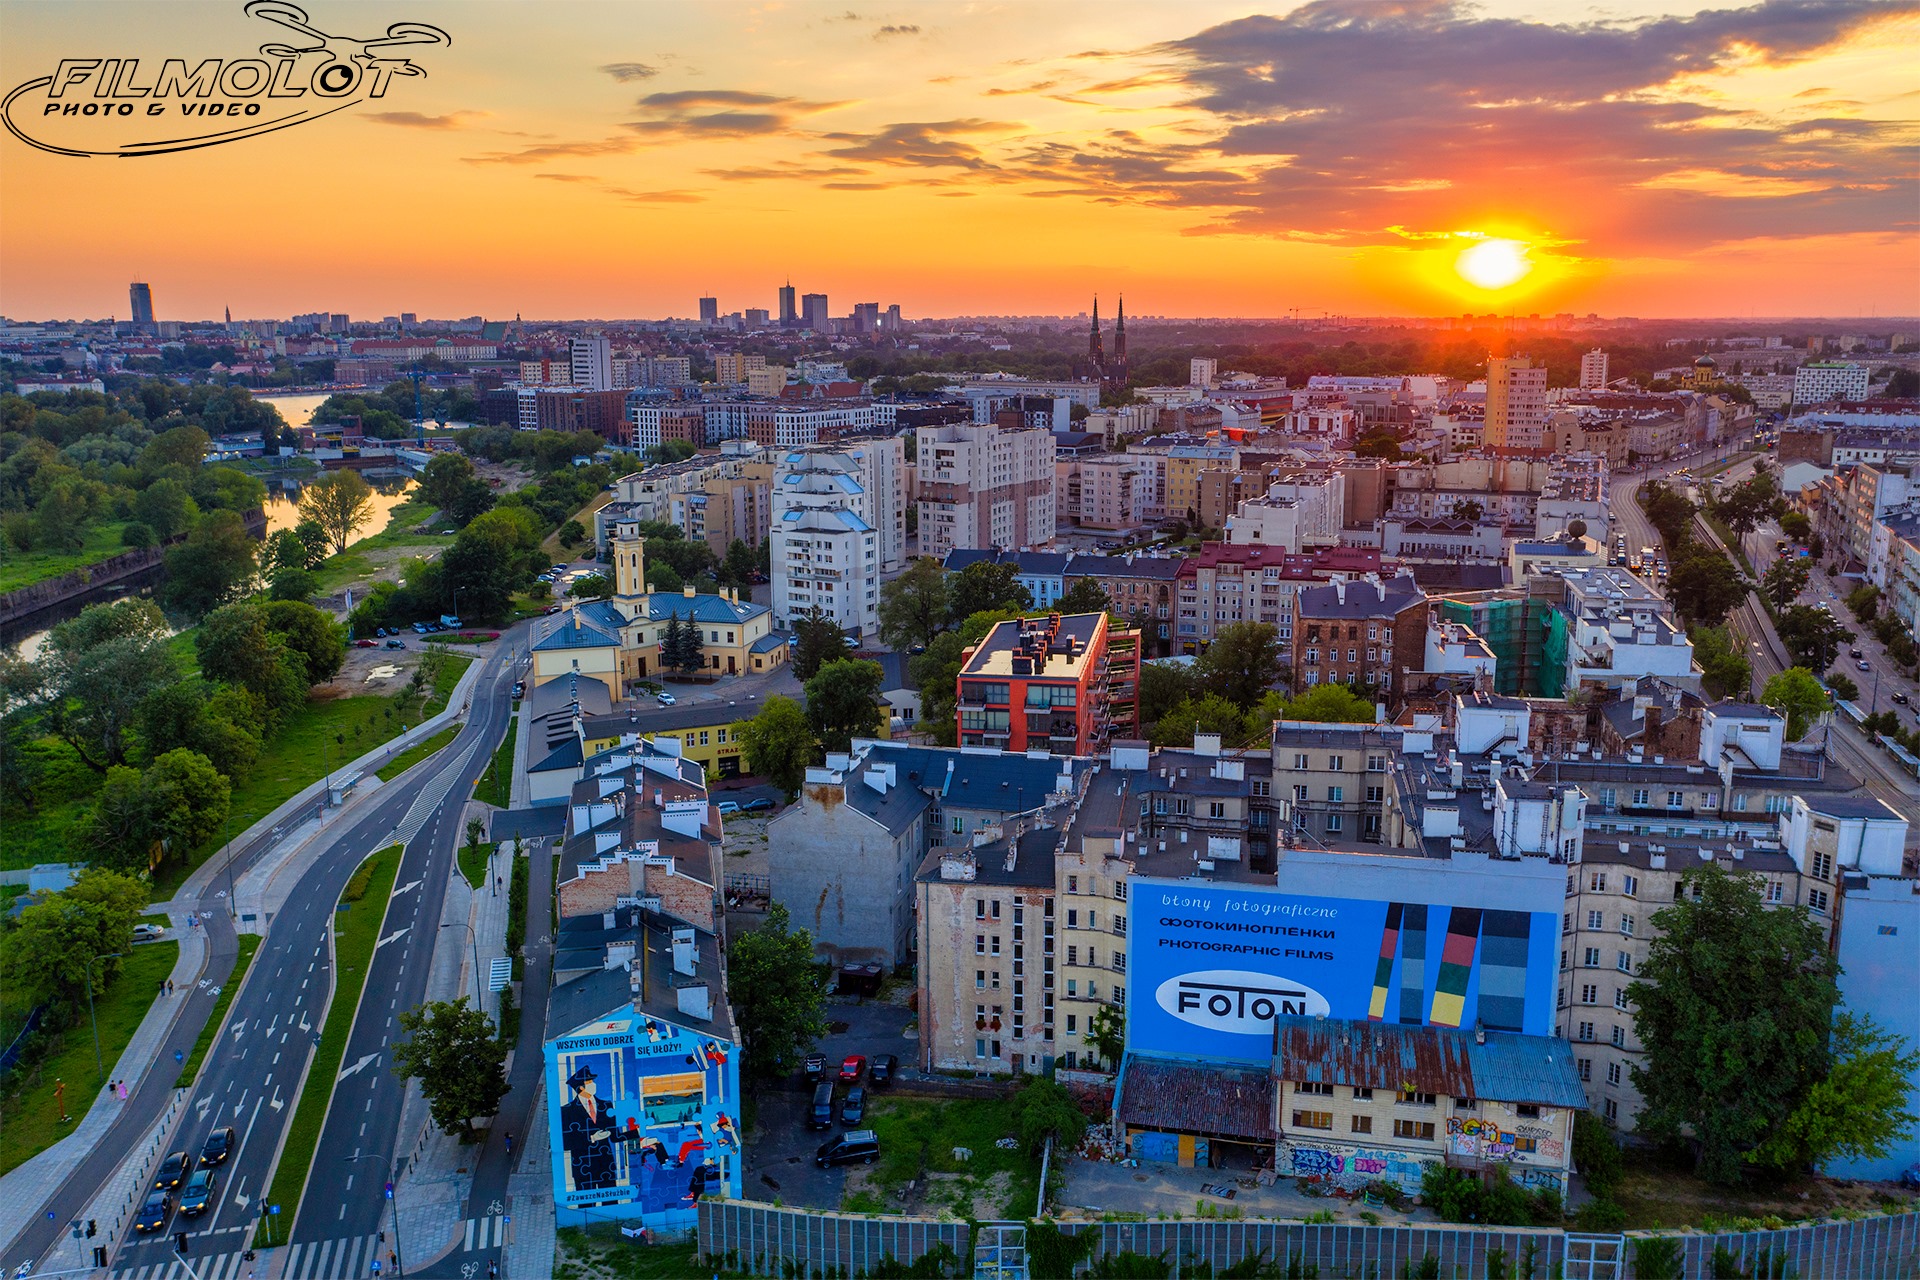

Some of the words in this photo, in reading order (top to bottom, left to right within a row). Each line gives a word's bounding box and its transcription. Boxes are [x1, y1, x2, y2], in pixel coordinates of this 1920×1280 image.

[1225, 899, 1338, 918] fotograficzne
[1158, 938, 1281, 957] PHOTOGRAPHIC
[1284, 948, 1334, 961] FILMS
[1178, 981, 1306, 1020] FOTON
[556, 1038, 601, 1050] WSZYSTKO
[603, 1035, 634, 1046] DOBRZE
[637, 1046, 651, 1056] SIĘ
[653, 1042, 682, 1054] UŁOŻY!
